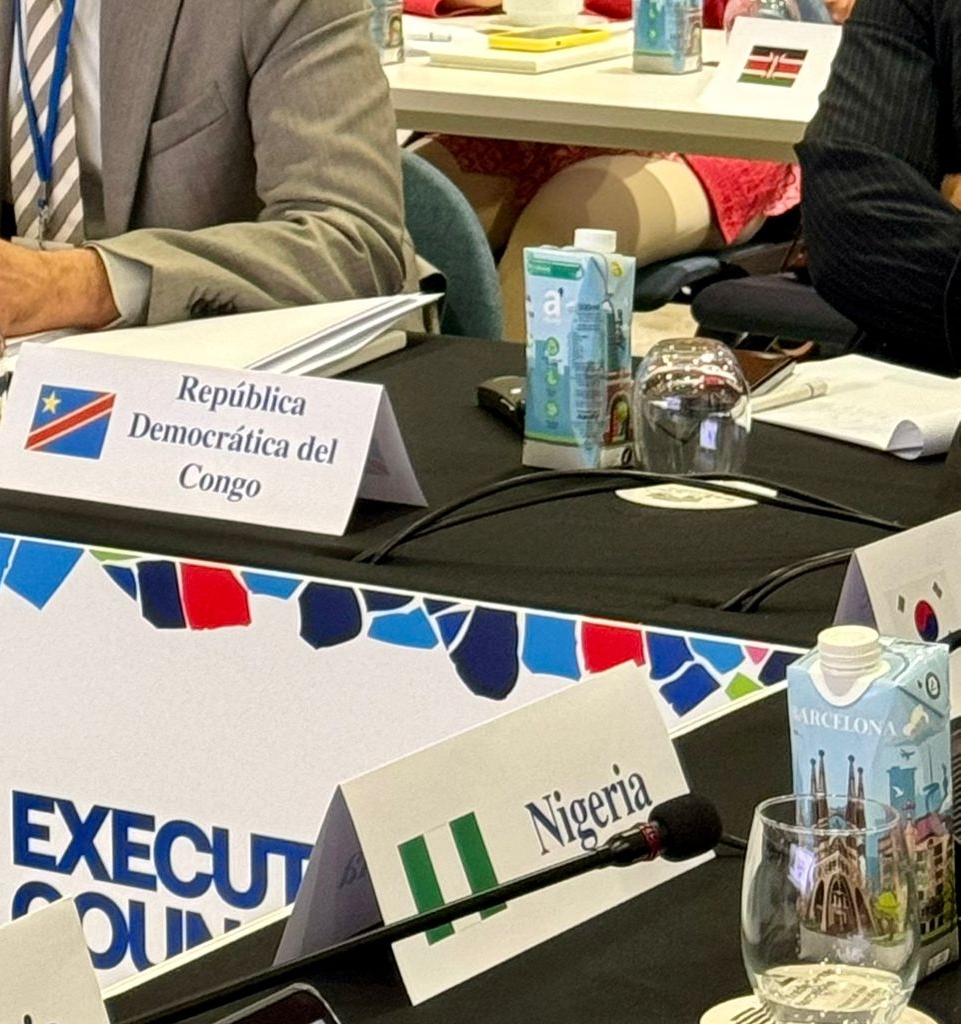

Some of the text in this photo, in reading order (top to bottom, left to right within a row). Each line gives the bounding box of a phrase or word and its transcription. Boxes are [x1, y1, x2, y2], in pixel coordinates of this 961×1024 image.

[176, 374, 307, 416] República
[128, 412, 339, 464] Democrática del
[178, 462, 261, 502] Congo
[525, 763, 653, 856] Nigeria
